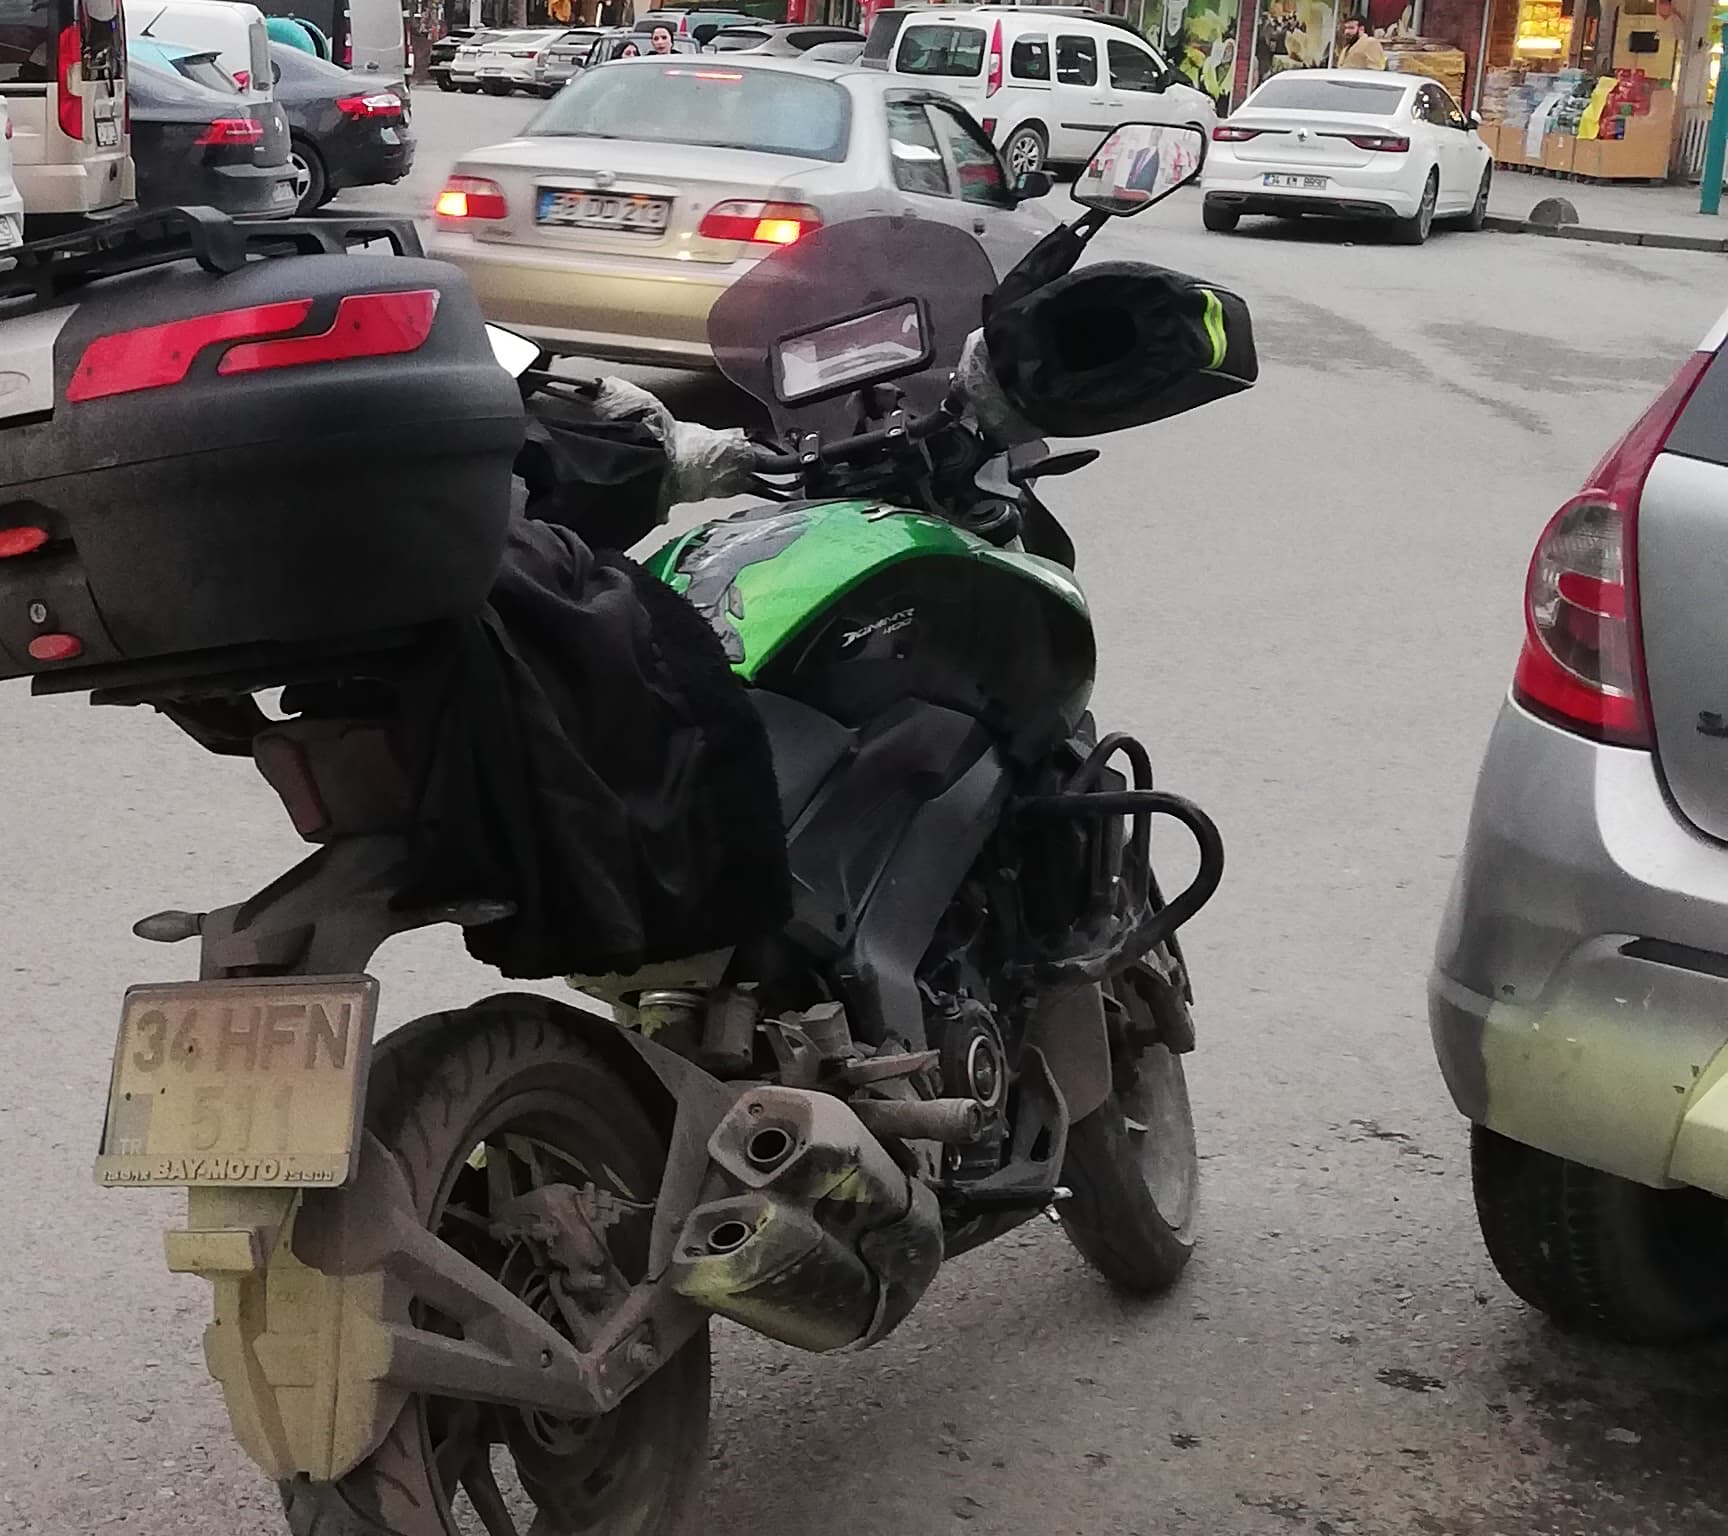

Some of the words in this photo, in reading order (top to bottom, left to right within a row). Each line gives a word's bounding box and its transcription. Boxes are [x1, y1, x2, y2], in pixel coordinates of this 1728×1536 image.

[133, 1007, 202, 1074] 34
[215, 1002, 353, 1072] HFN
[152, 1158, 282, 1181] BAY-MOTO
